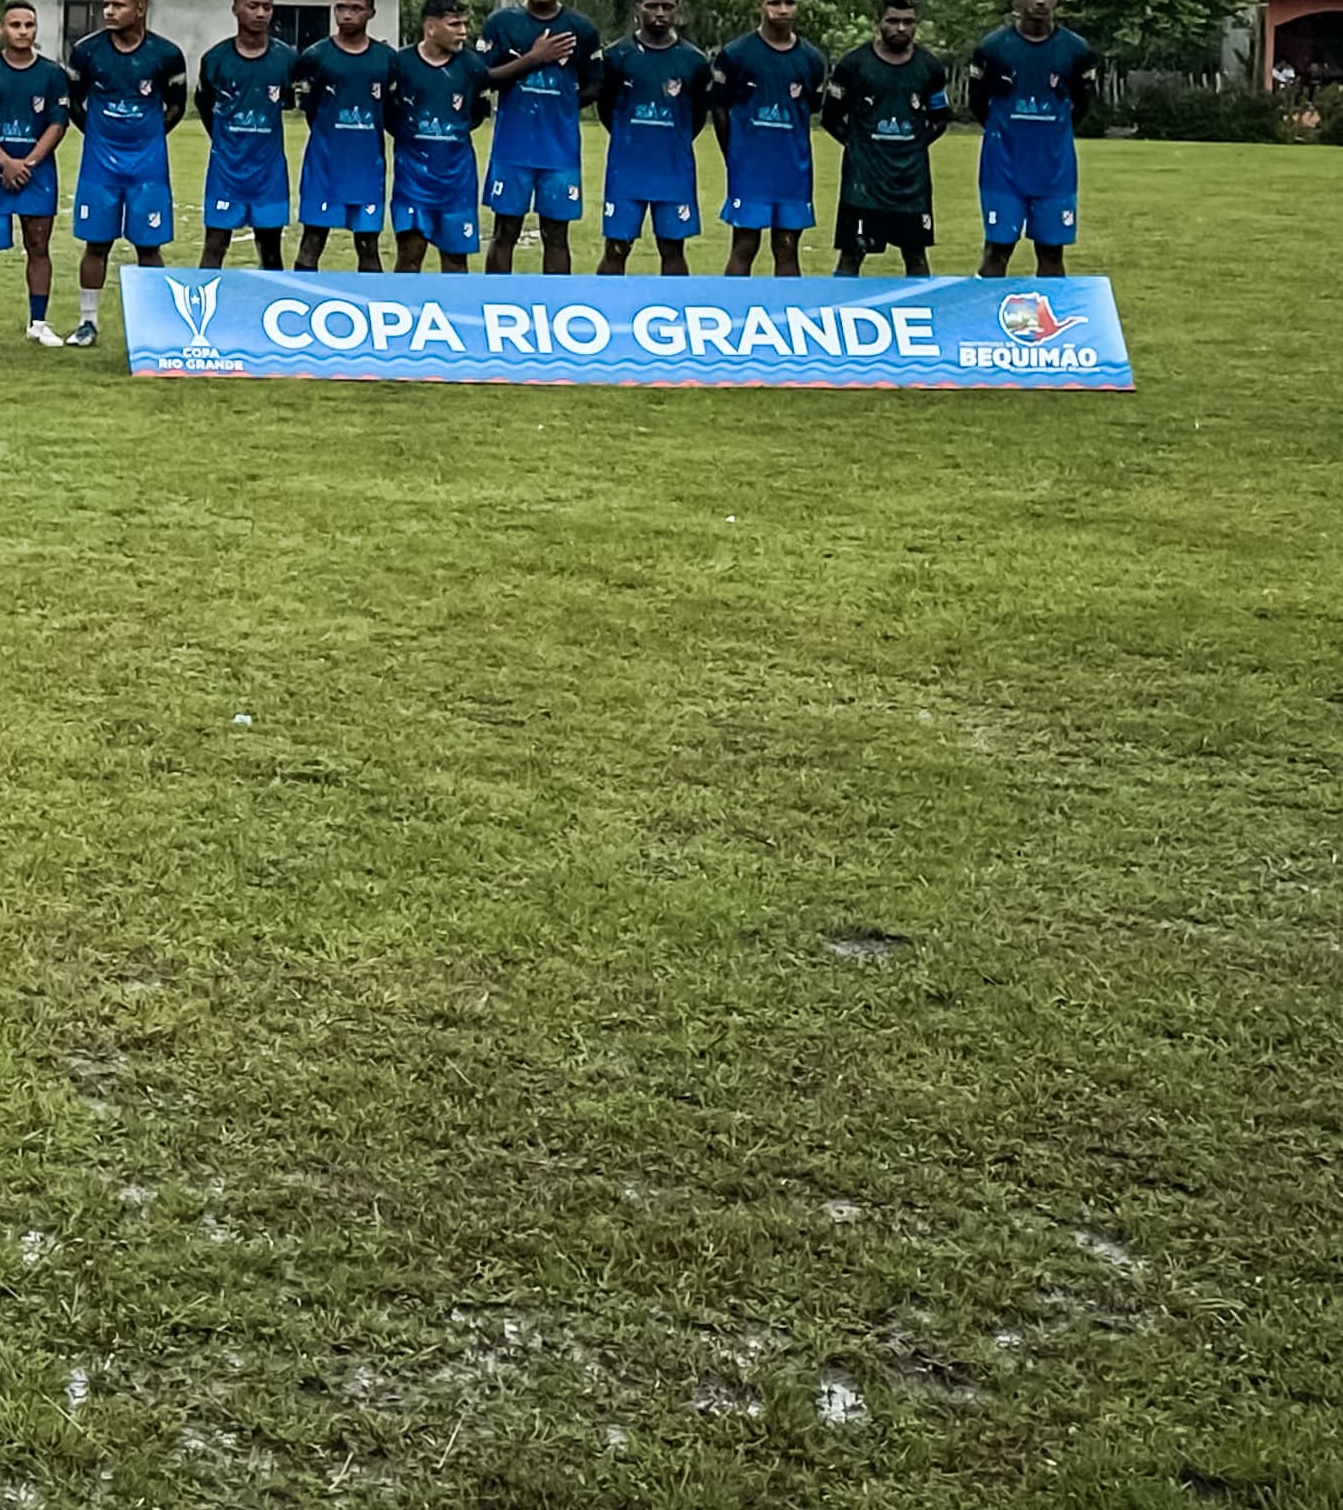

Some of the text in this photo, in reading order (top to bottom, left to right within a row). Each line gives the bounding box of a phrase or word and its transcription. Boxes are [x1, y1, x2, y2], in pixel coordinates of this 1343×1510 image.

[261, 298, 941, 358] COPA RIO GRANDE
[182, 347, 221, 359] COPA
[959, 343, 1098, 370] BEQUIMÃO
[158, 358, 244, 371] RIO GRANDE
